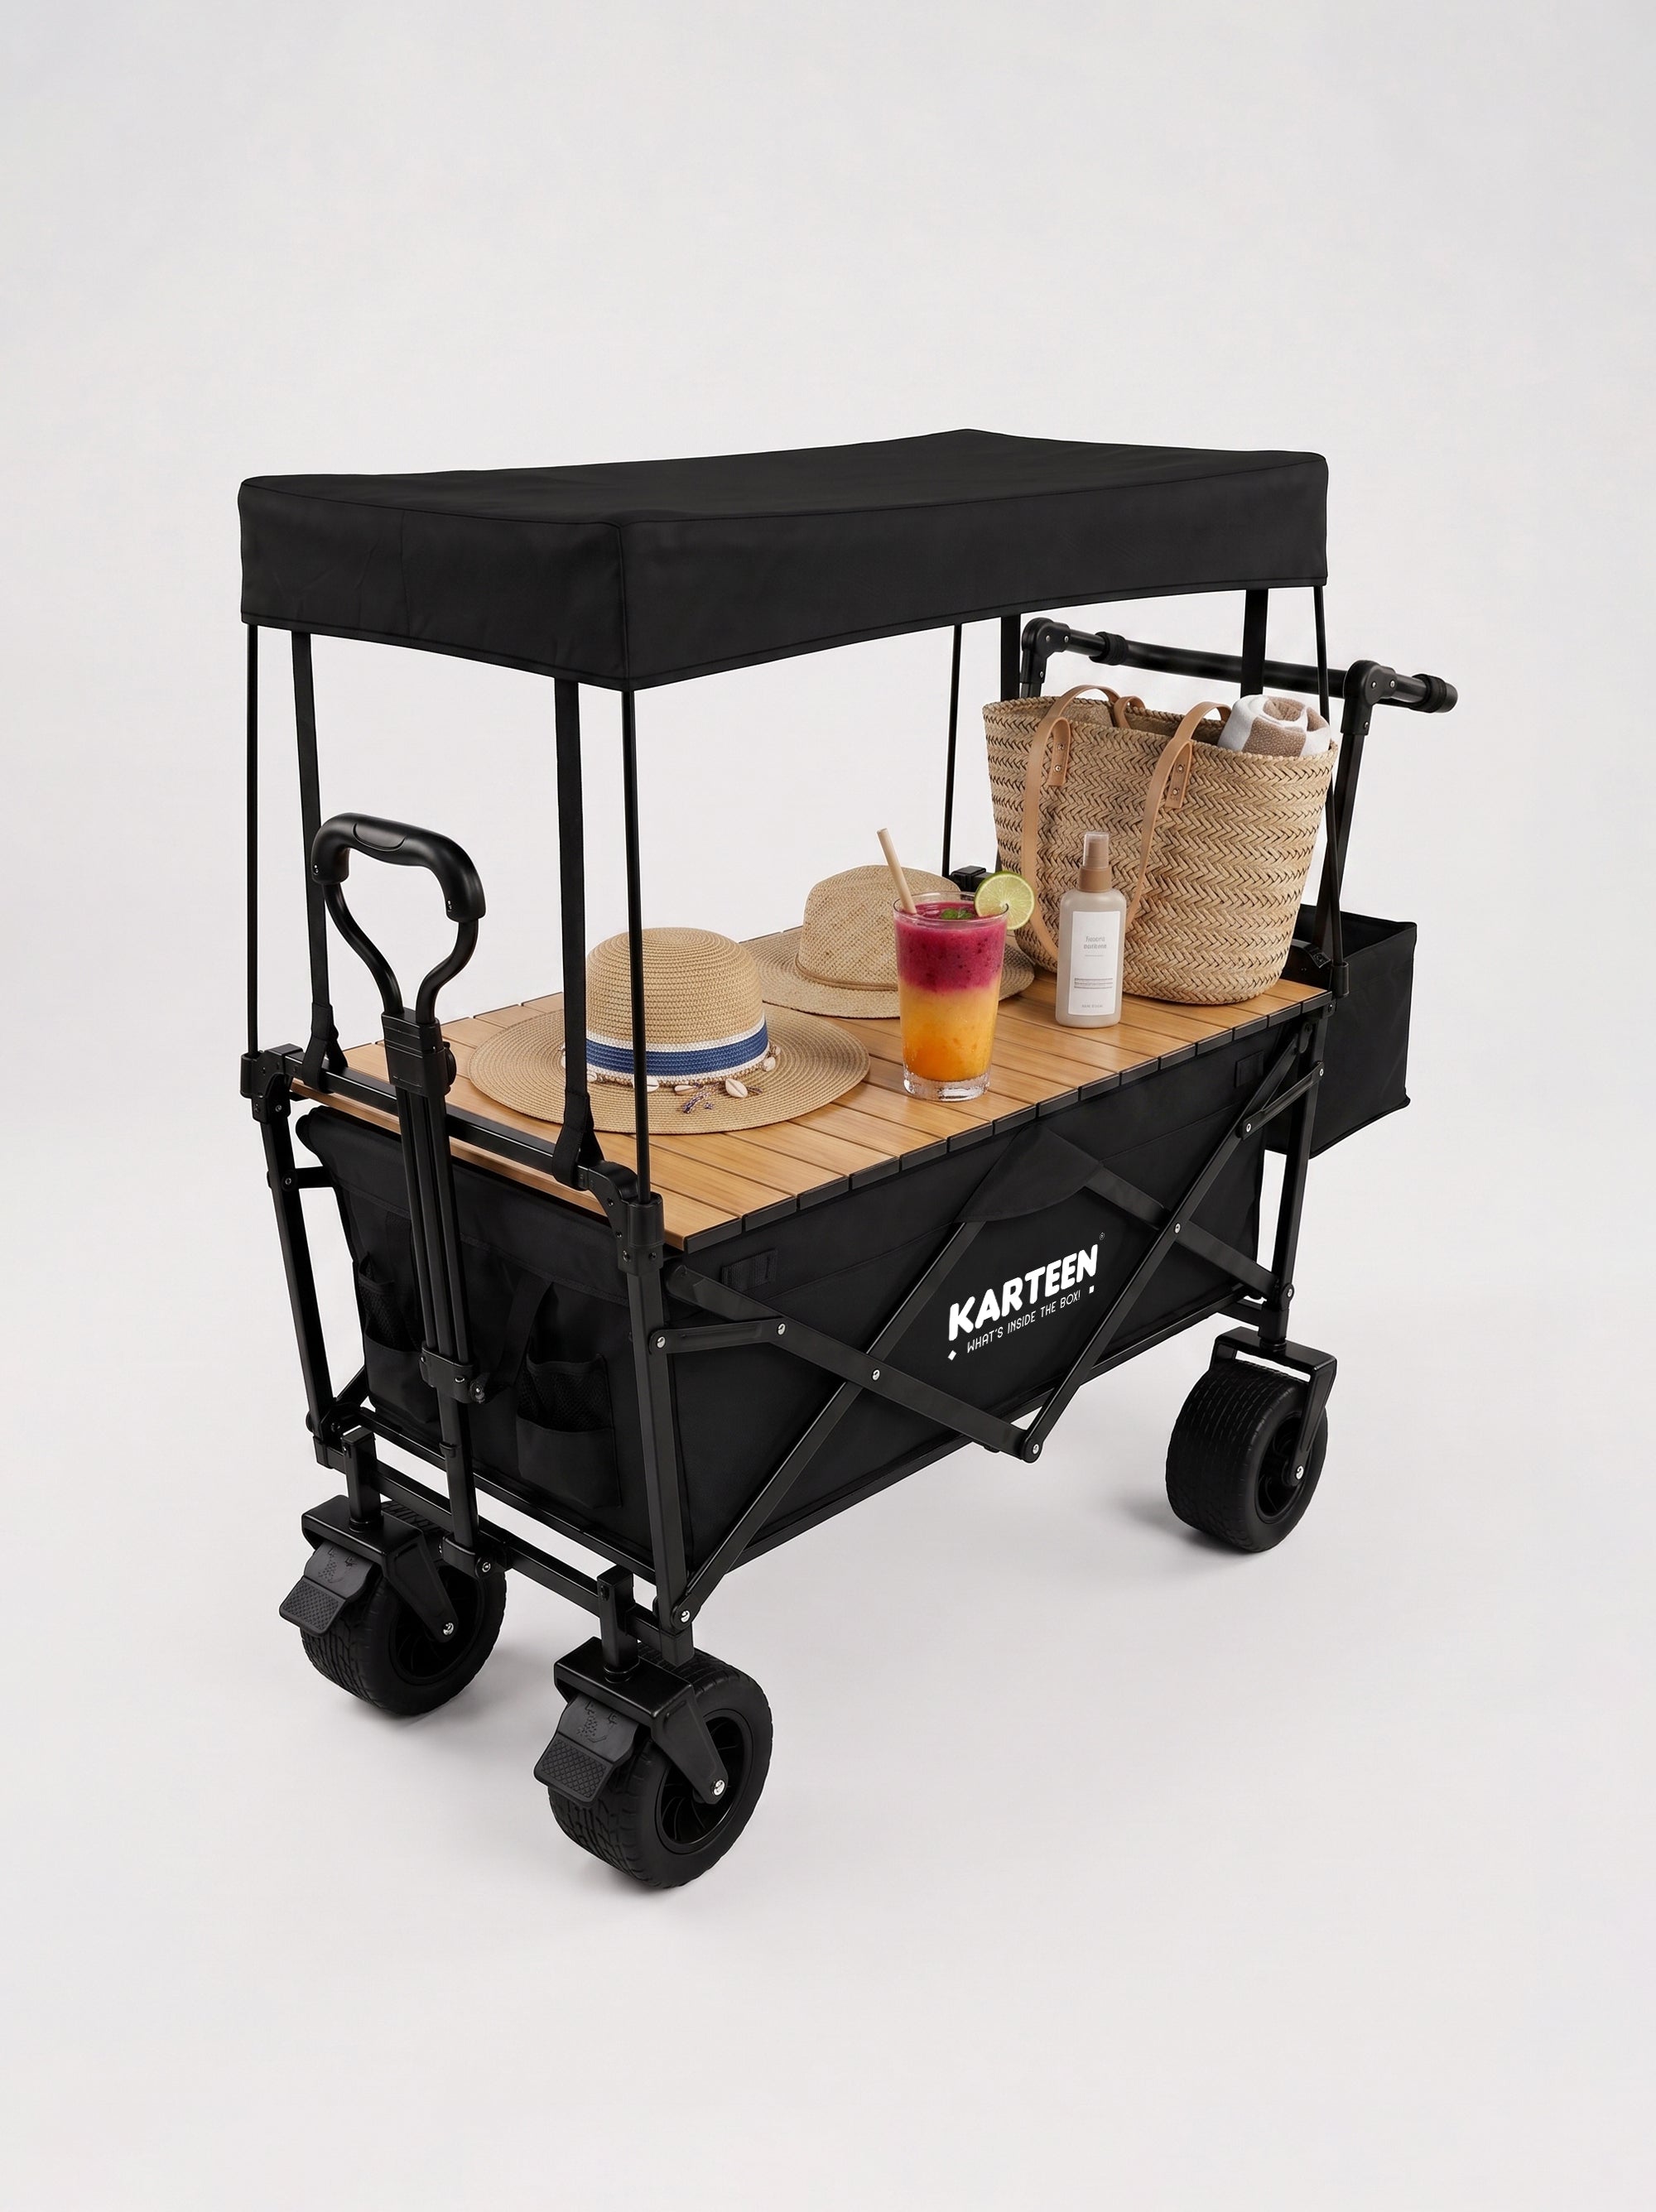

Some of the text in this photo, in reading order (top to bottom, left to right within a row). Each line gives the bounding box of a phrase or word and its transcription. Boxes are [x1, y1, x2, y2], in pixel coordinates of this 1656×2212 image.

[948, 1243, 1099, 1341] KARTEEN
[967, 1289, 1081, 1354] WHAT'S INSIDE THE BOX!
